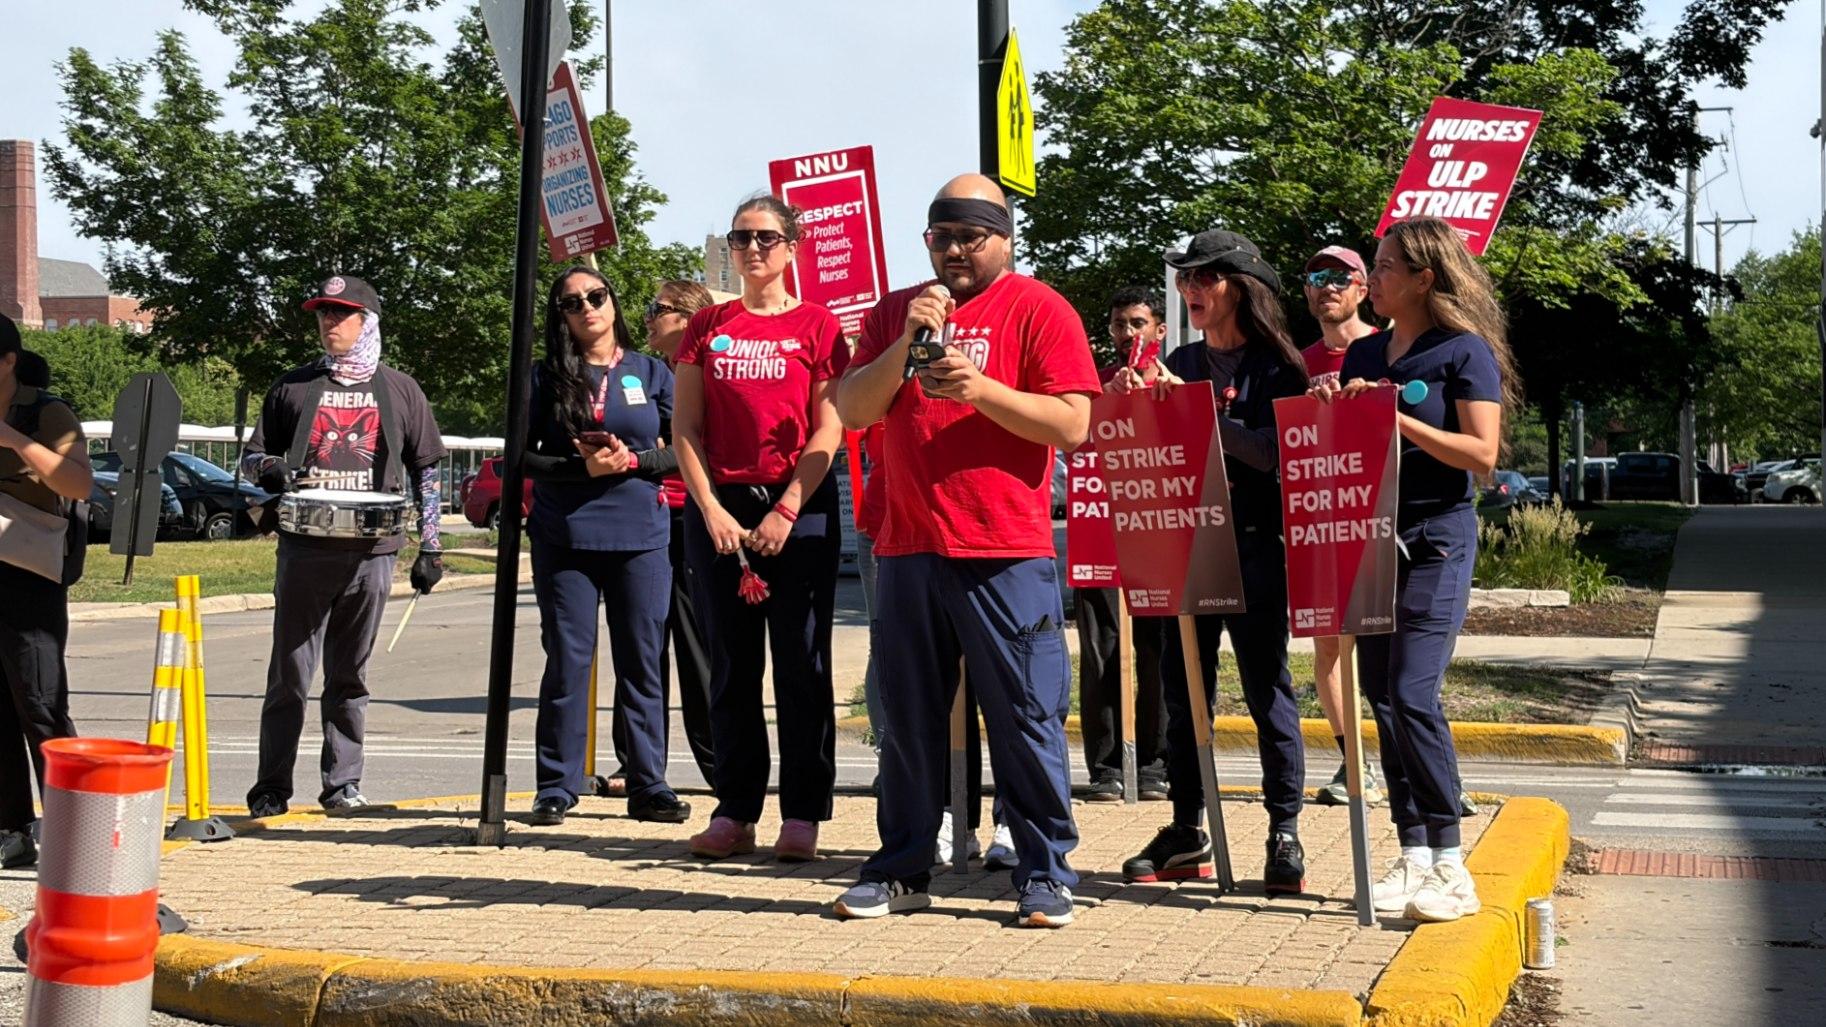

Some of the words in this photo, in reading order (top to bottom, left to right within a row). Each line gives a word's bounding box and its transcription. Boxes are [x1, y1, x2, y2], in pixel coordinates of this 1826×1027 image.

[1426, 118, 1529, 142] NURSES
[1429, 143, 1454, 158] ON
[794, 152, 848, 178] NNU
[1427, 160, 1487, 188] ULP
[543, 165, 589, 193] ORGANIZING
[546, 183, 594, 217] NURSES
[1390, 190, 1499, 220] STRIKE
[813, 221, 845, 239] Protect
[815, 238, 853, 254] Patients,
[817, 250, 851, 268] Respect
[819, 268, 849, 284] Nurses
[714, 357, 786, 380] STRONG
[319, 391, 378, 408] ENERA
[1097, 418, 1135, 441] ON
[1284, 424, 1319, 449] ON
[1104, 445, 1186, 470] STRIKE
[1286, 452, 1364, 481] STRIKE
[308, 466, 374, 490] STRIKE!
[1072, 477, 1107, 494] FO
[1111, 479, 1157, 501] FOR
[1161, 476, 1197, 498] MY
[1288, 489, 1332, 514] FOR
[1338, 485, 1373, 509] MY
[1115, 505, 1226, 532] PATIENTS
[1290, 516, 1392, 547] PATIENTS
[1198, 598, 1239, 607] #RNStrike
